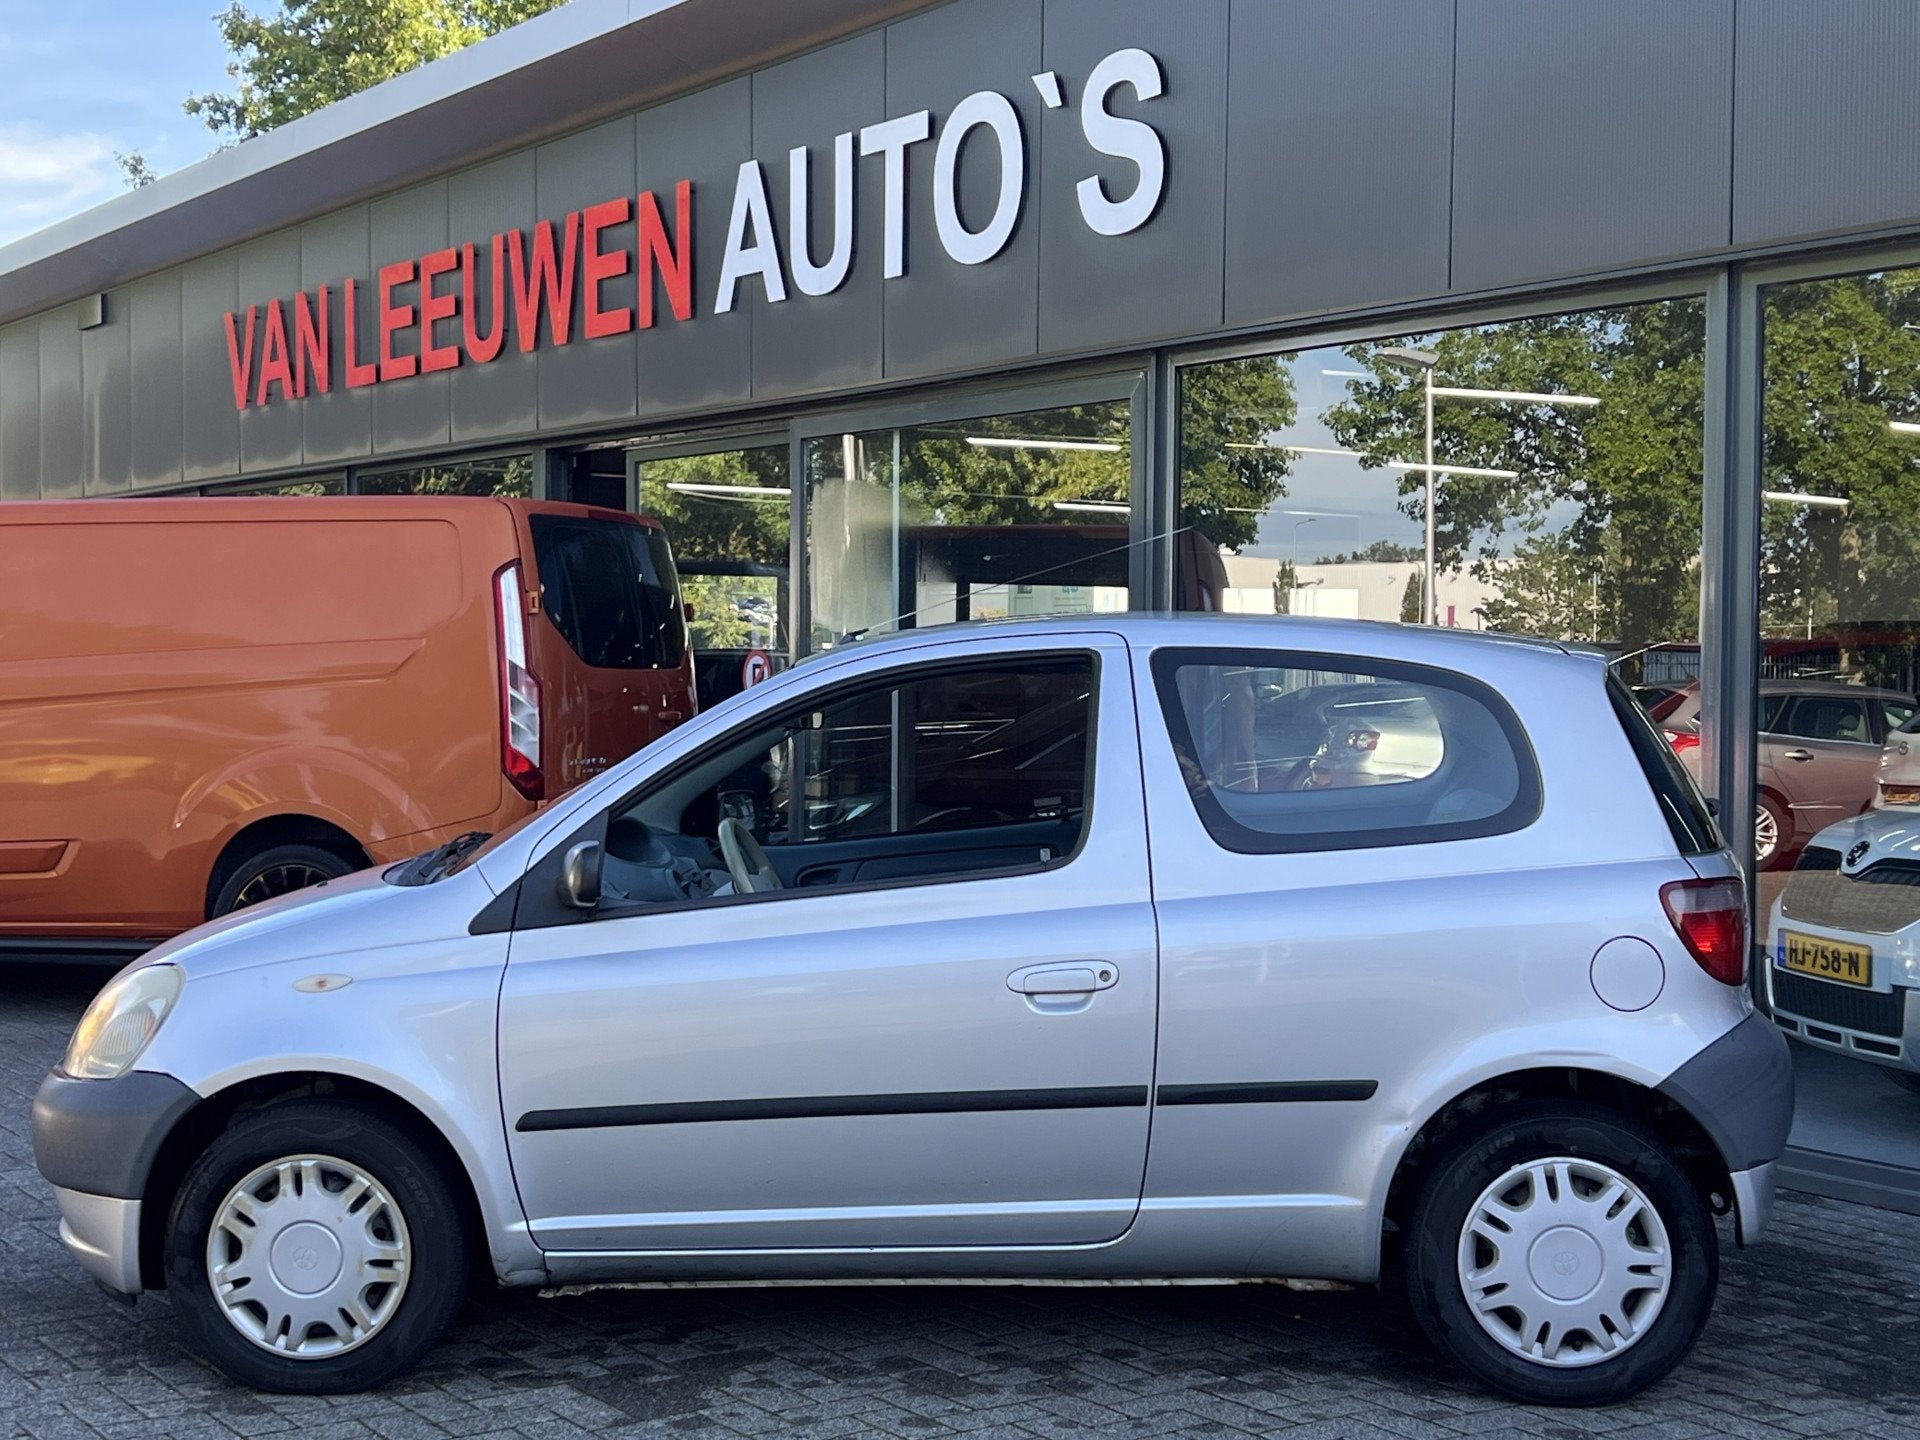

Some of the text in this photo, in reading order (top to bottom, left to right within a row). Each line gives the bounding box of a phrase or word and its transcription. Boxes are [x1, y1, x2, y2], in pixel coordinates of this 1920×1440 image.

[223, 283, 330, 411] VAN
[344, 178, 693, 390] LEEUWEN
[1788, 938, 1860, 978] HJ-758-N
